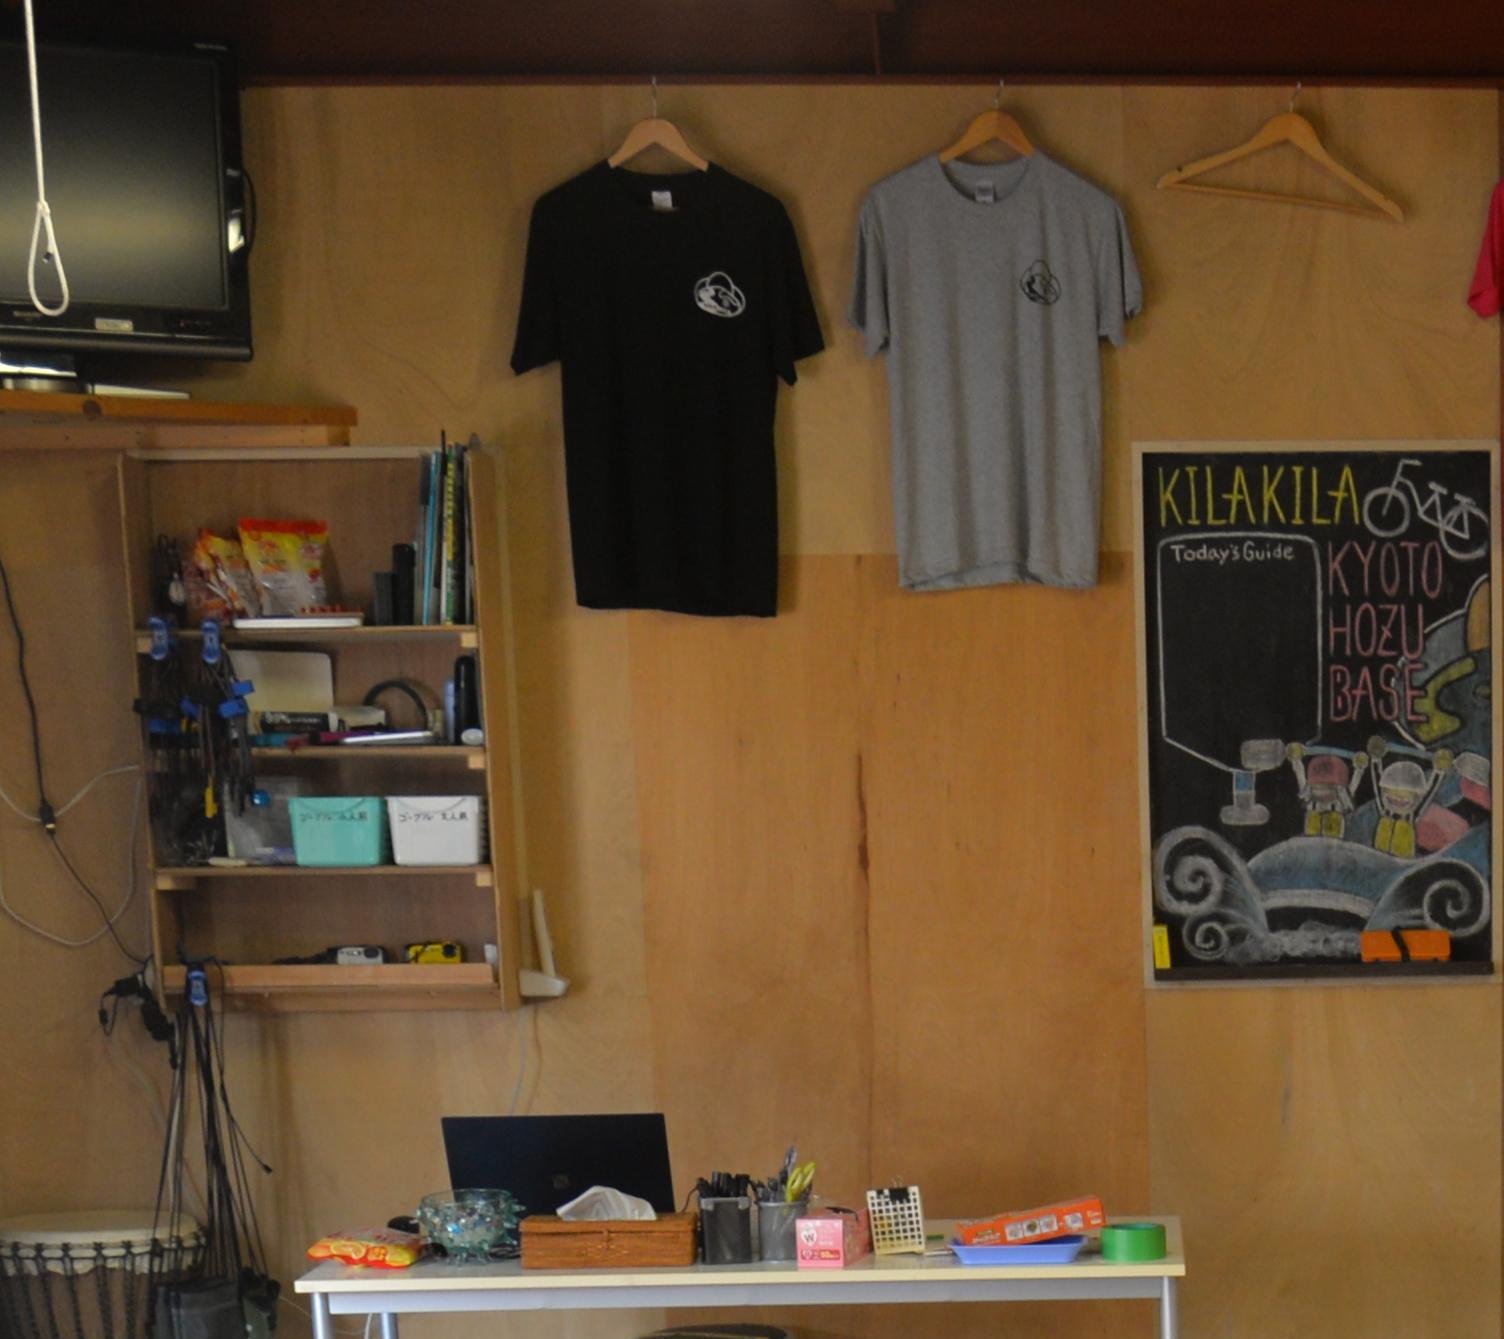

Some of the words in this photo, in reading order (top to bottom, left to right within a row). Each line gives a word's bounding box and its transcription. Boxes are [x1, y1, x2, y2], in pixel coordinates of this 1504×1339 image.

[1158, 465, 1361, 527] KILAKILA
[1171, 544, 1241, 563] Today's
[1243, 542, 1295, 562] Guide
[1328, 541, 1444, 597] KYOTO
[1329, 603, 1424, 659] HOZU
[1329, 663, 1428, 723] BASE
